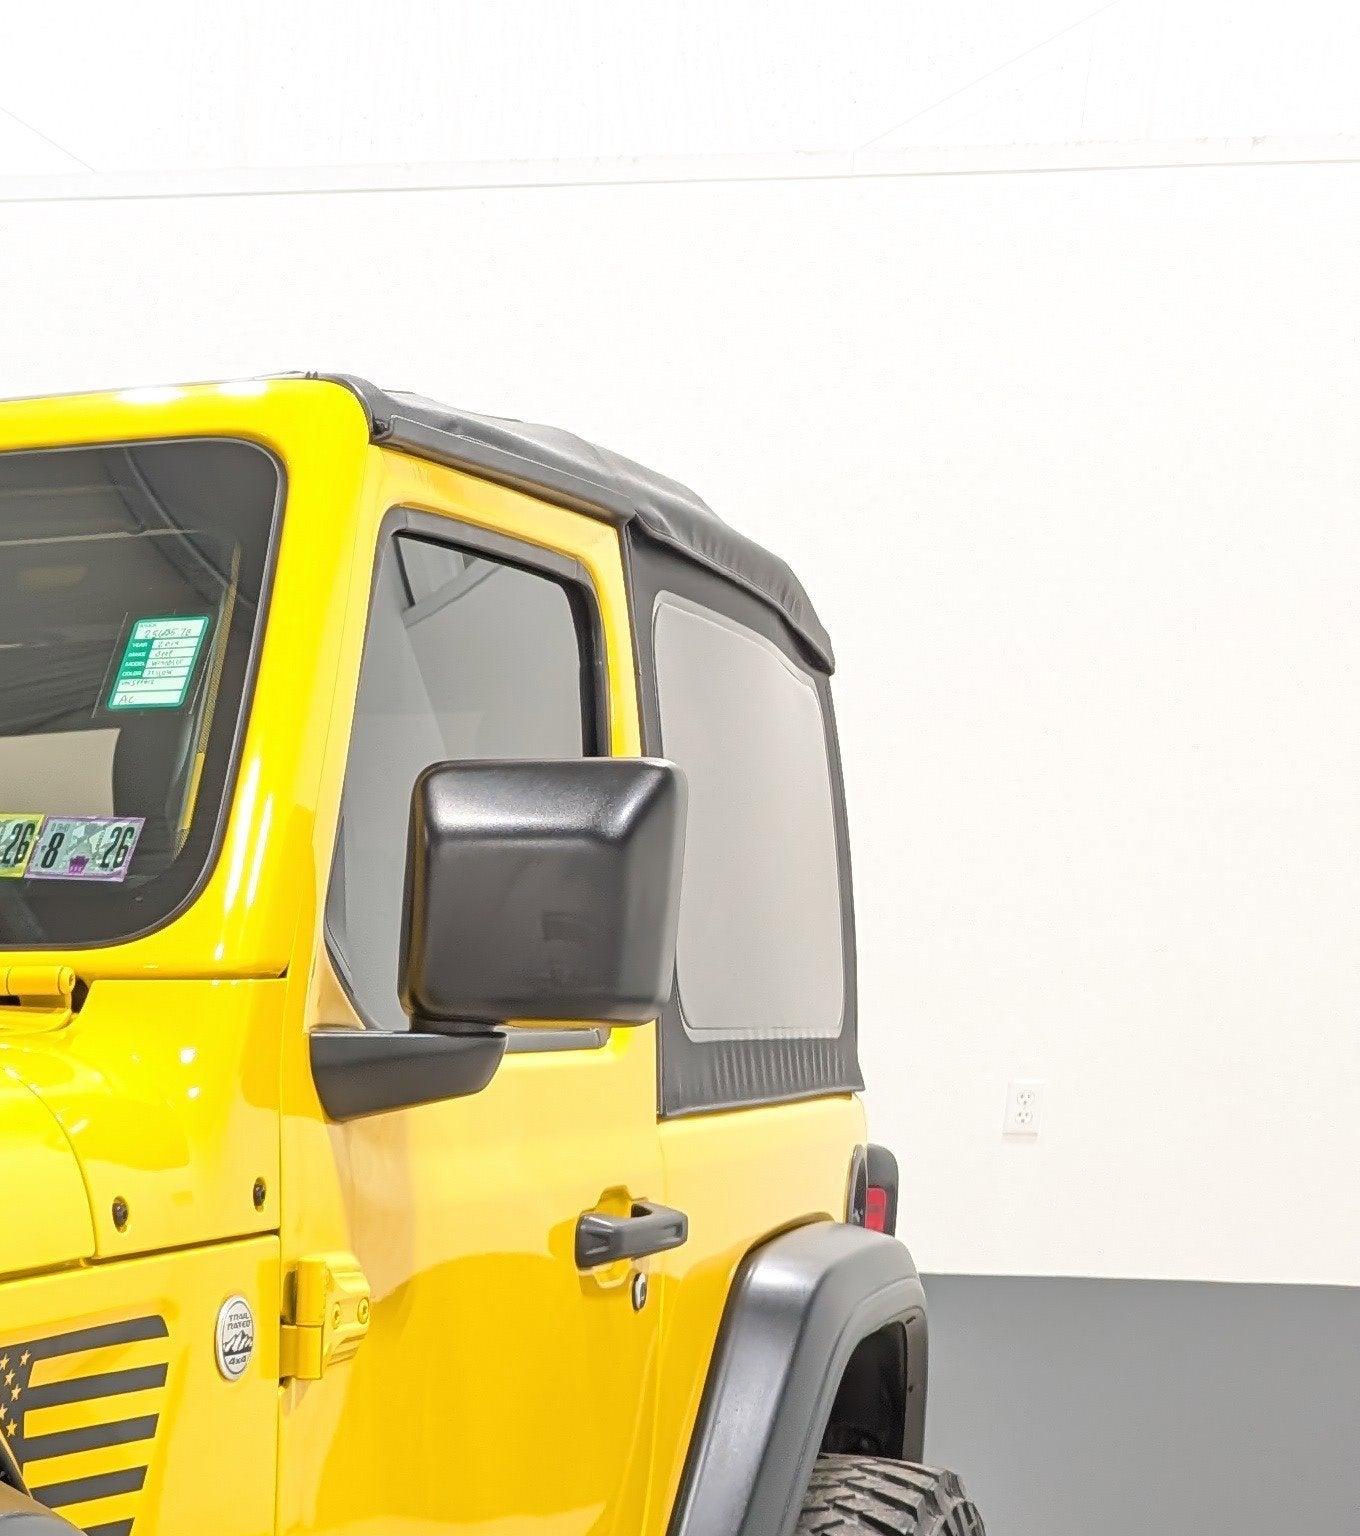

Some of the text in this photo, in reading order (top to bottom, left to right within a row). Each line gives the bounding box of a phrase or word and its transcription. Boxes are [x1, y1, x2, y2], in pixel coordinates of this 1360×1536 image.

[1, 823, 36, 865] 26
[40, 826, 135, 869] 8 26
[227, 1320, 250, 1331] RATED
[228, 1312, 249, 1322] TRAIL
